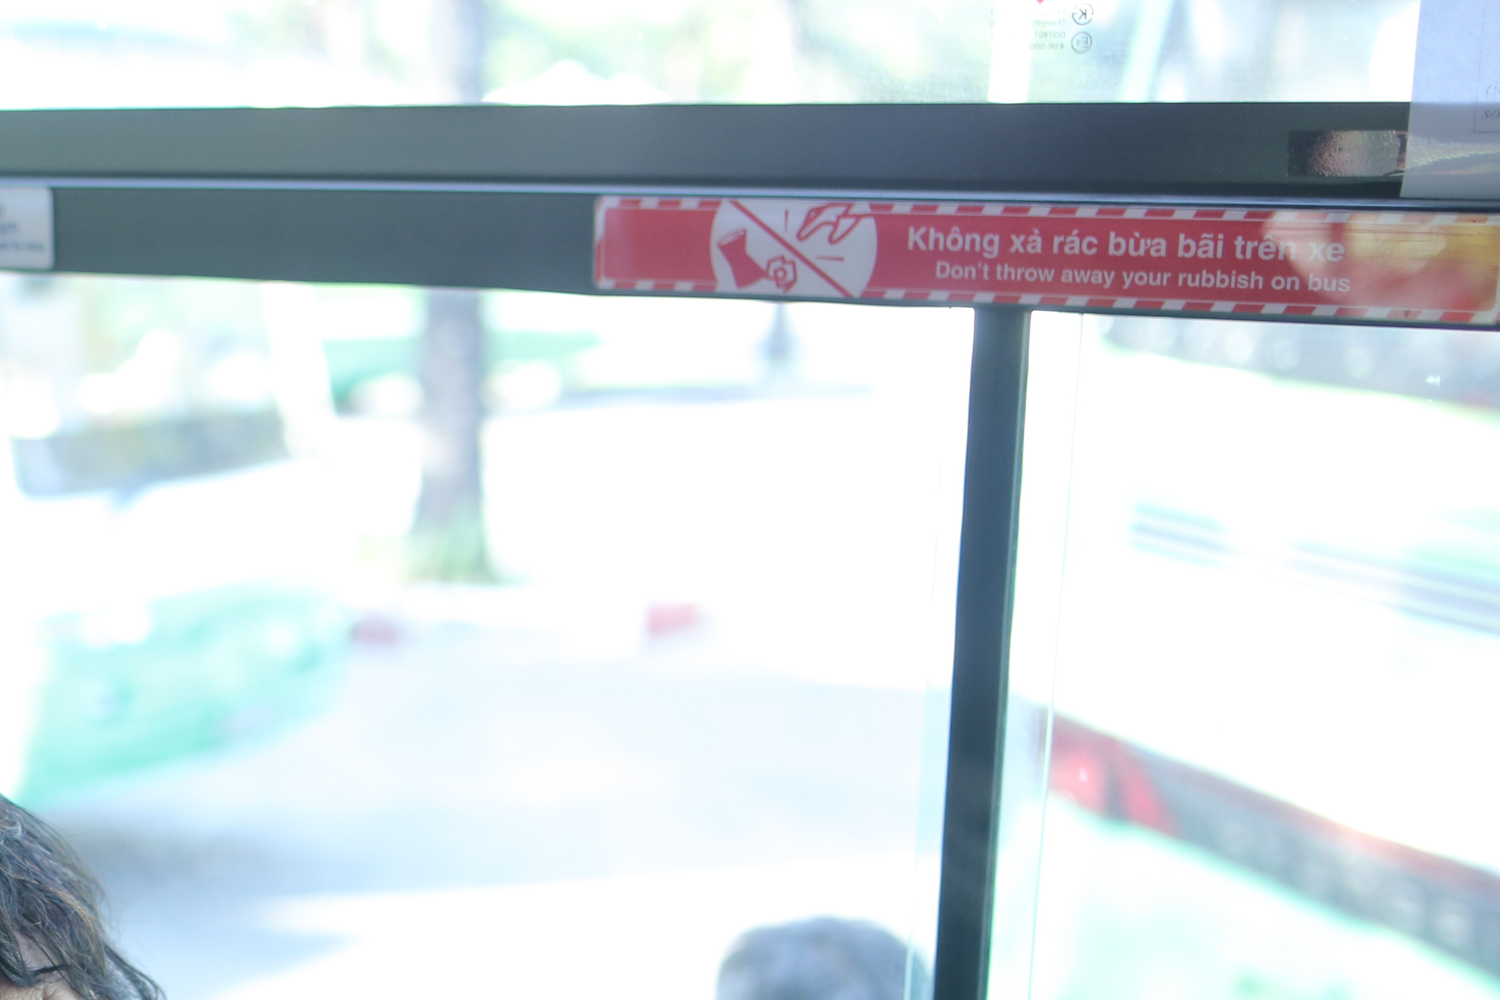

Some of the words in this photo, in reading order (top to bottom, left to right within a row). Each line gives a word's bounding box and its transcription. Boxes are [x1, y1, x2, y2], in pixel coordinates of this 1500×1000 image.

[907, 225, 1000, 259] Không
[1009, 228, 1042, 254] xả
[1052, 229, 1098, 255] rác
[1108, 231, 1167, 258] bừa
[1177, 232, 1225, 259] bãi
[1234, 234, 1297, 261] trên
[1308, 240, 1345, 262] xe
[935, 260, 989, 280] Don't
[995, 263, 1055, 283] throw
[1061, 269, 1115, 289] away
[1122, 270, 1171, 289] your
[1177, 270, 1264, 290] rubbish
[1271, 276, 1300, 291] on
[1308, 273, 1350, 293] bus
